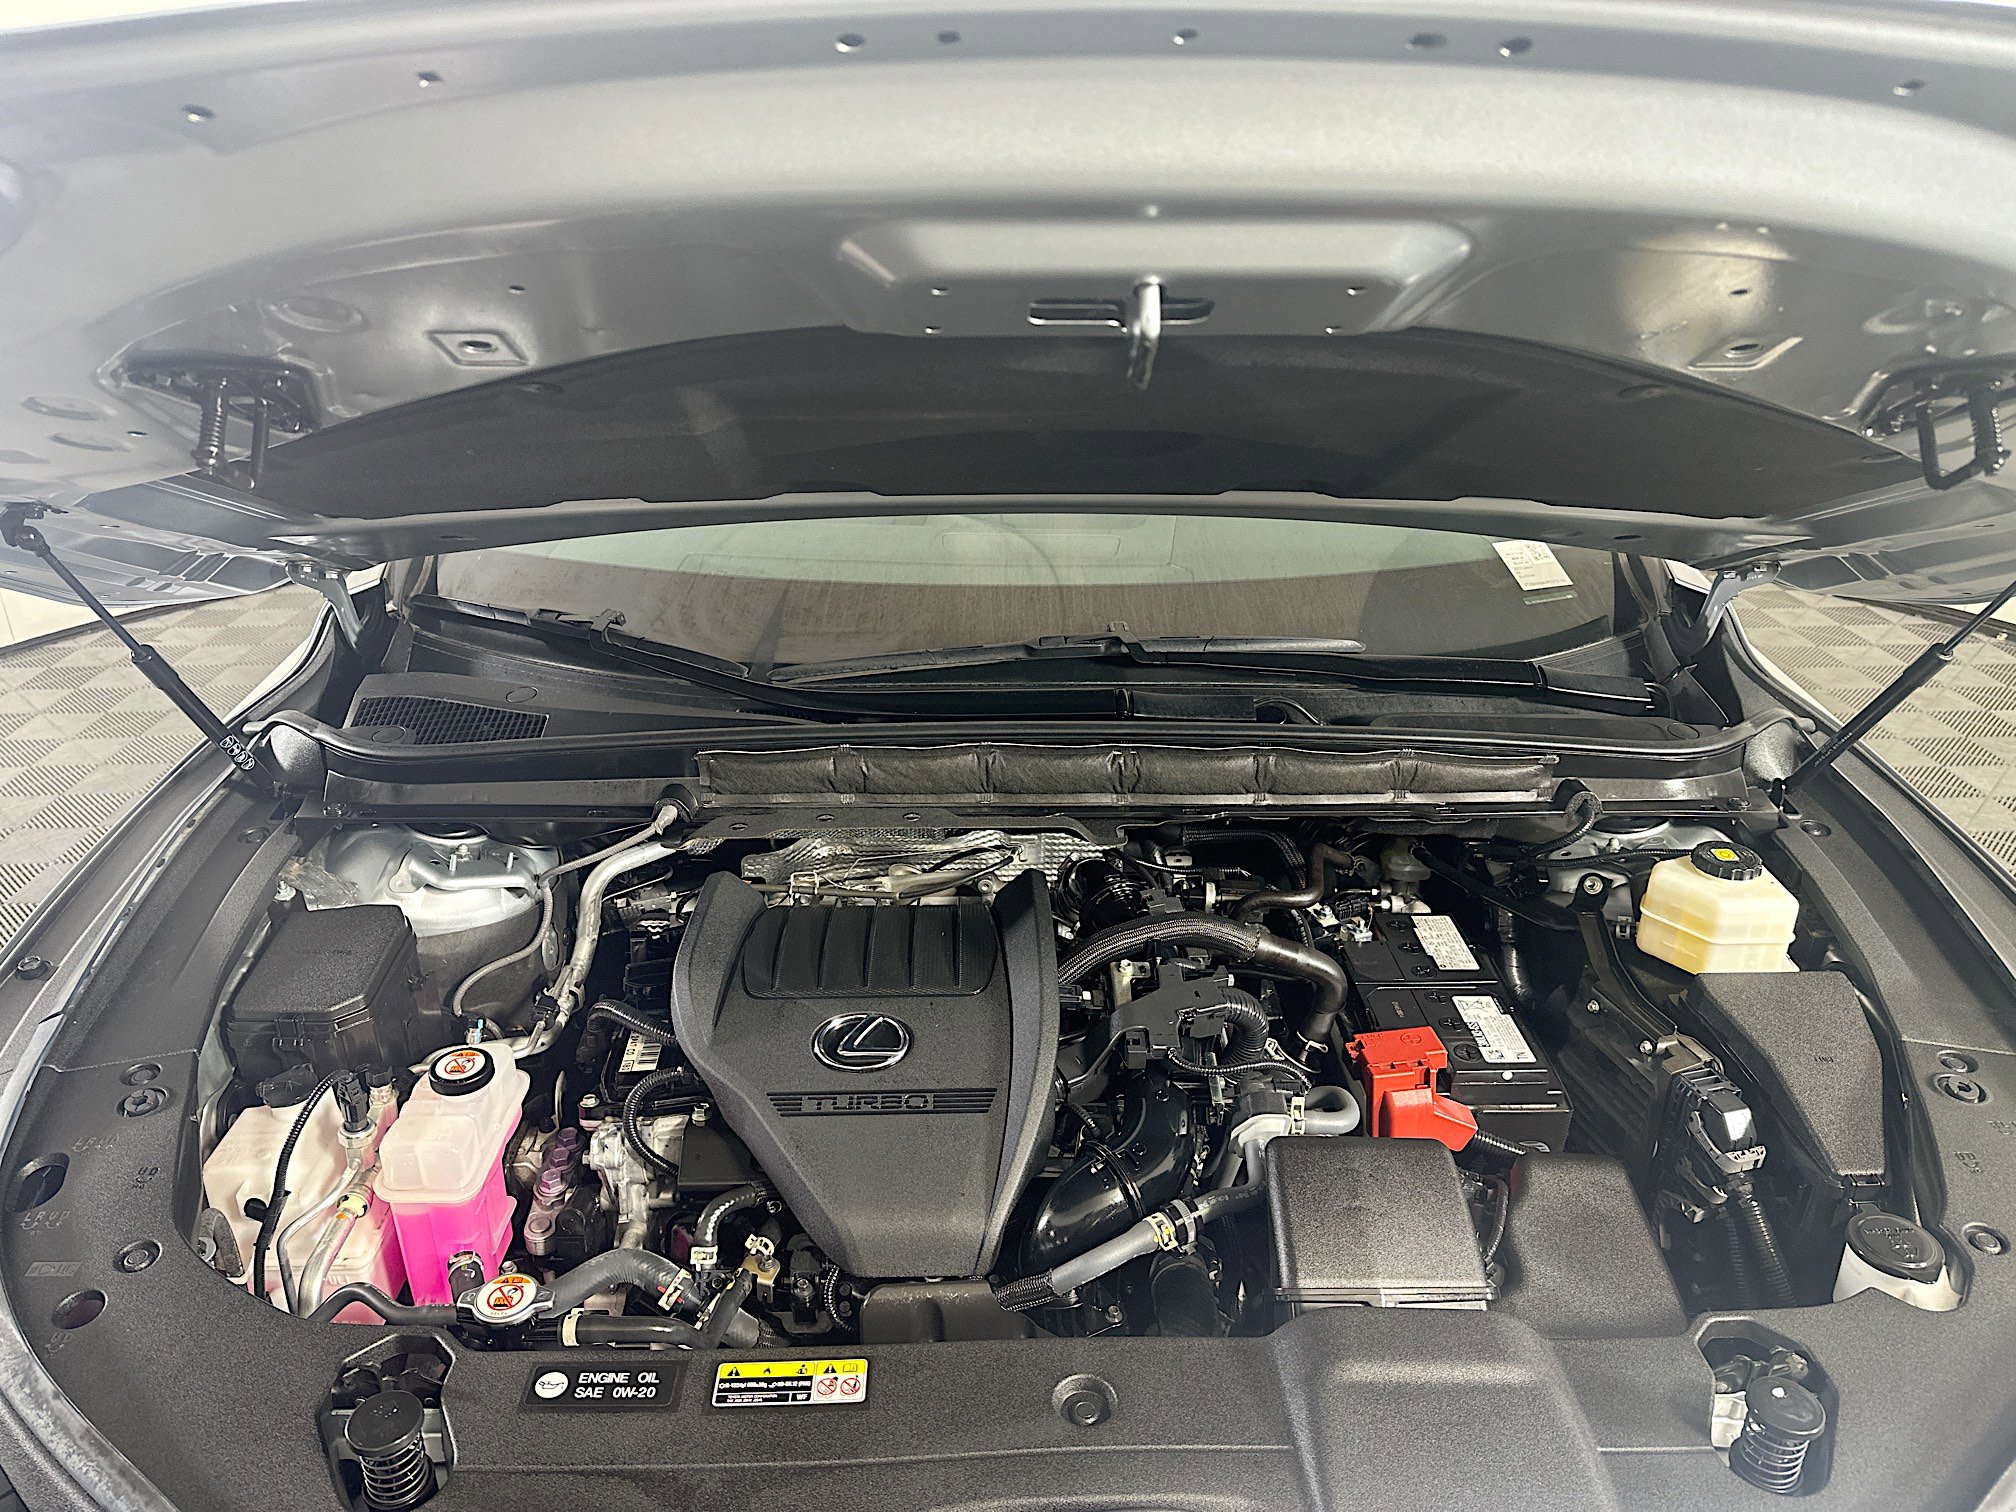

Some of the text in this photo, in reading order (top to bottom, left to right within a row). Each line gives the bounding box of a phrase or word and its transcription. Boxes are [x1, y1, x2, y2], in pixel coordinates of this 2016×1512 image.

[807, 1093, 929, 1111] TURBO
[578, 1371, 660, 1384] ENGINE OIL
[574, 1386, 656, 1398] SAE 0W-20
